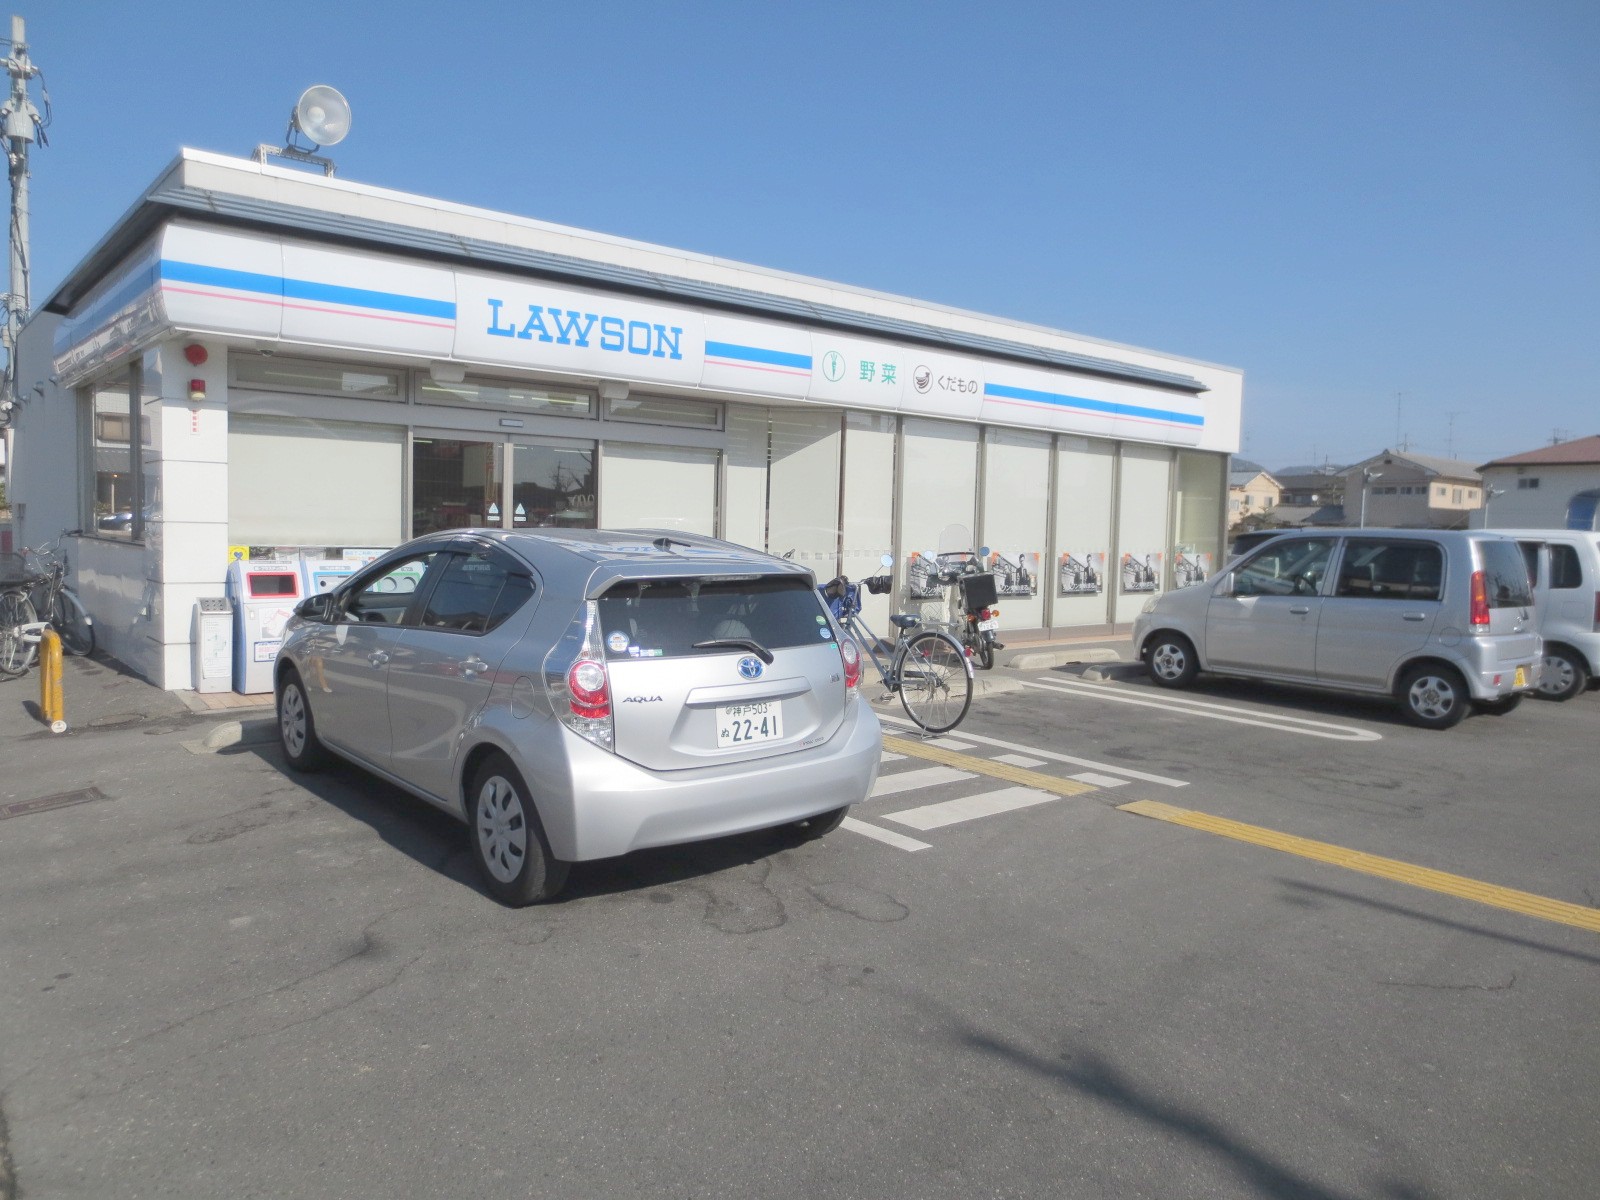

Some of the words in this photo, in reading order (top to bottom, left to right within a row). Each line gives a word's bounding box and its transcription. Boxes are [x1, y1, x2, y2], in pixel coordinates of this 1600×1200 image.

[487, 298, 683, 360] LAWSON
[859, 359, 897, 385] 野菜
[937, 374, 978, 394] くだもの
[622, 695, 663, 704] AQUA
[732, 715, 777, 742] 22-41
